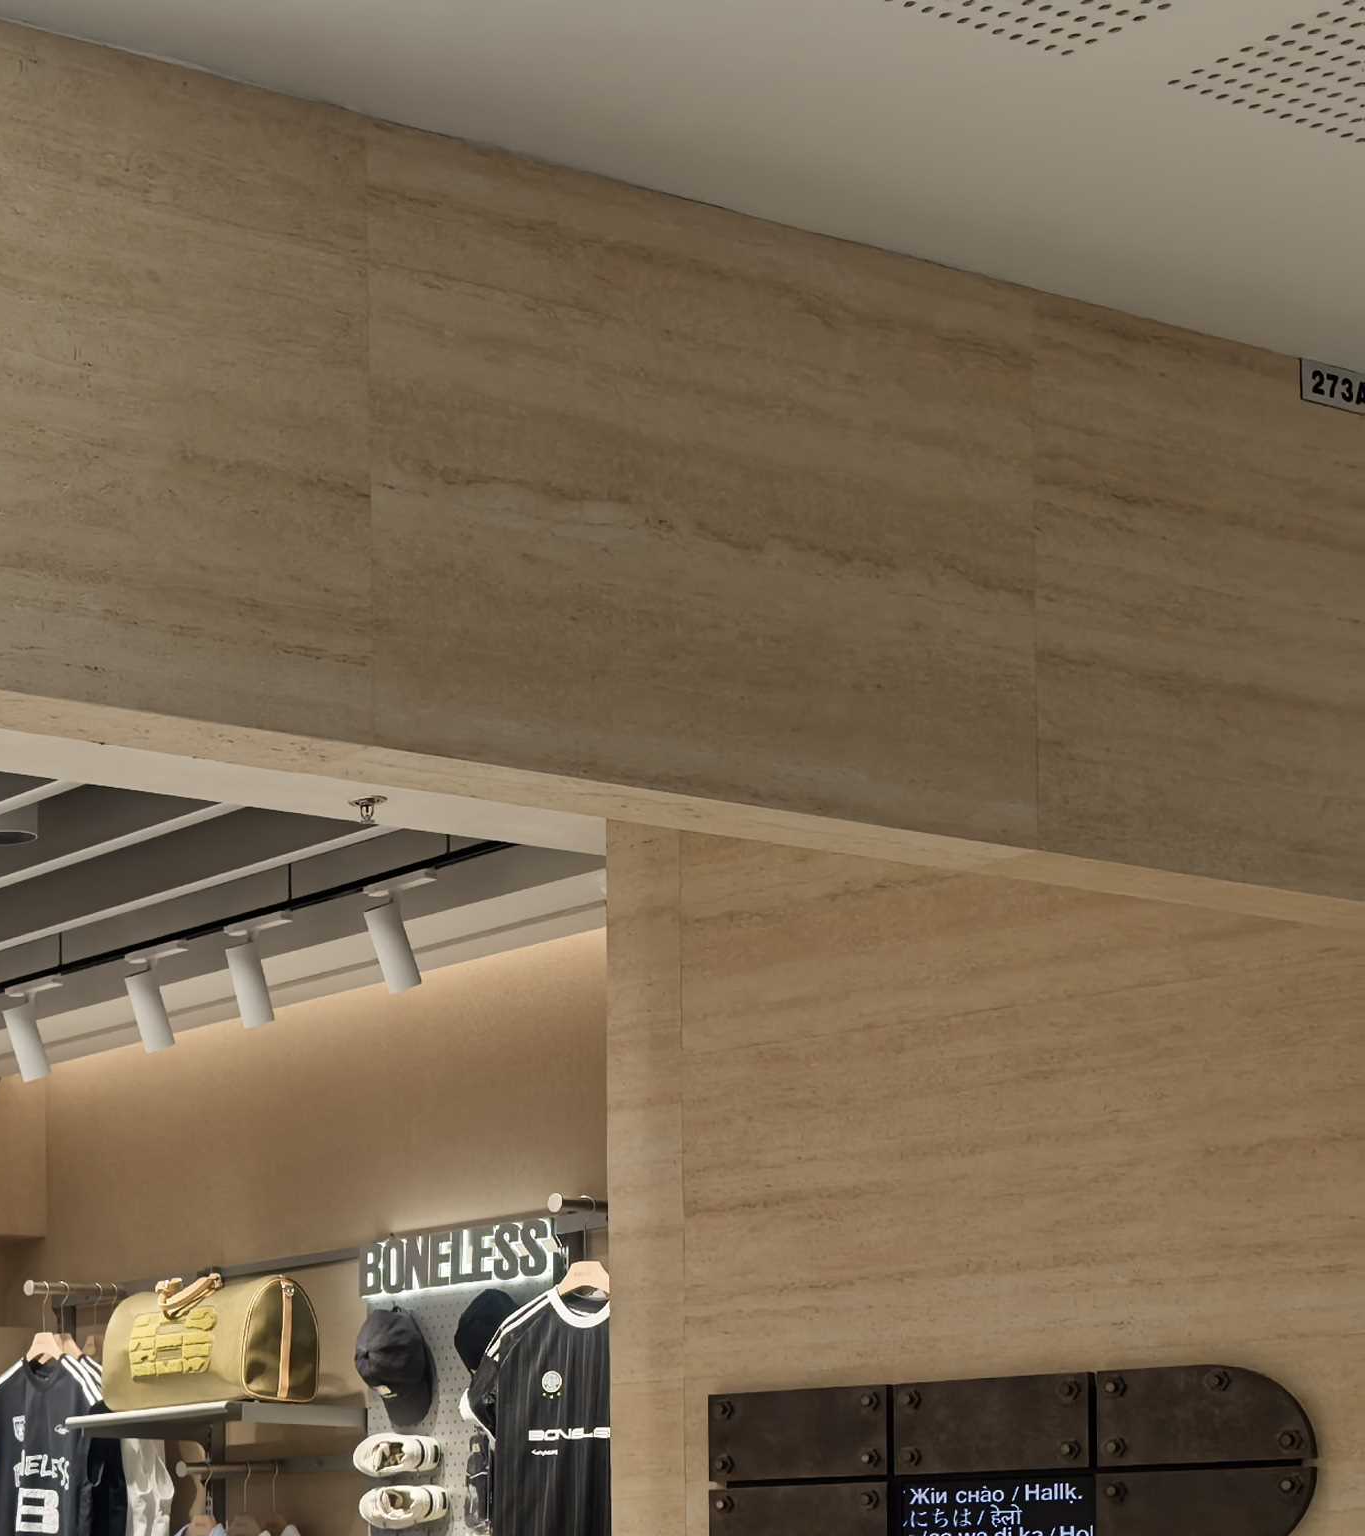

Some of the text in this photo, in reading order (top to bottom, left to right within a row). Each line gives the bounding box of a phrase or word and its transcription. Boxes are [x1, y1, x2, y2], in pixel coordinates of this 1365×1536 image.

[361, 1217, 548, 1296] BONELESS
[903, 1508, 972, 1528] にちは
